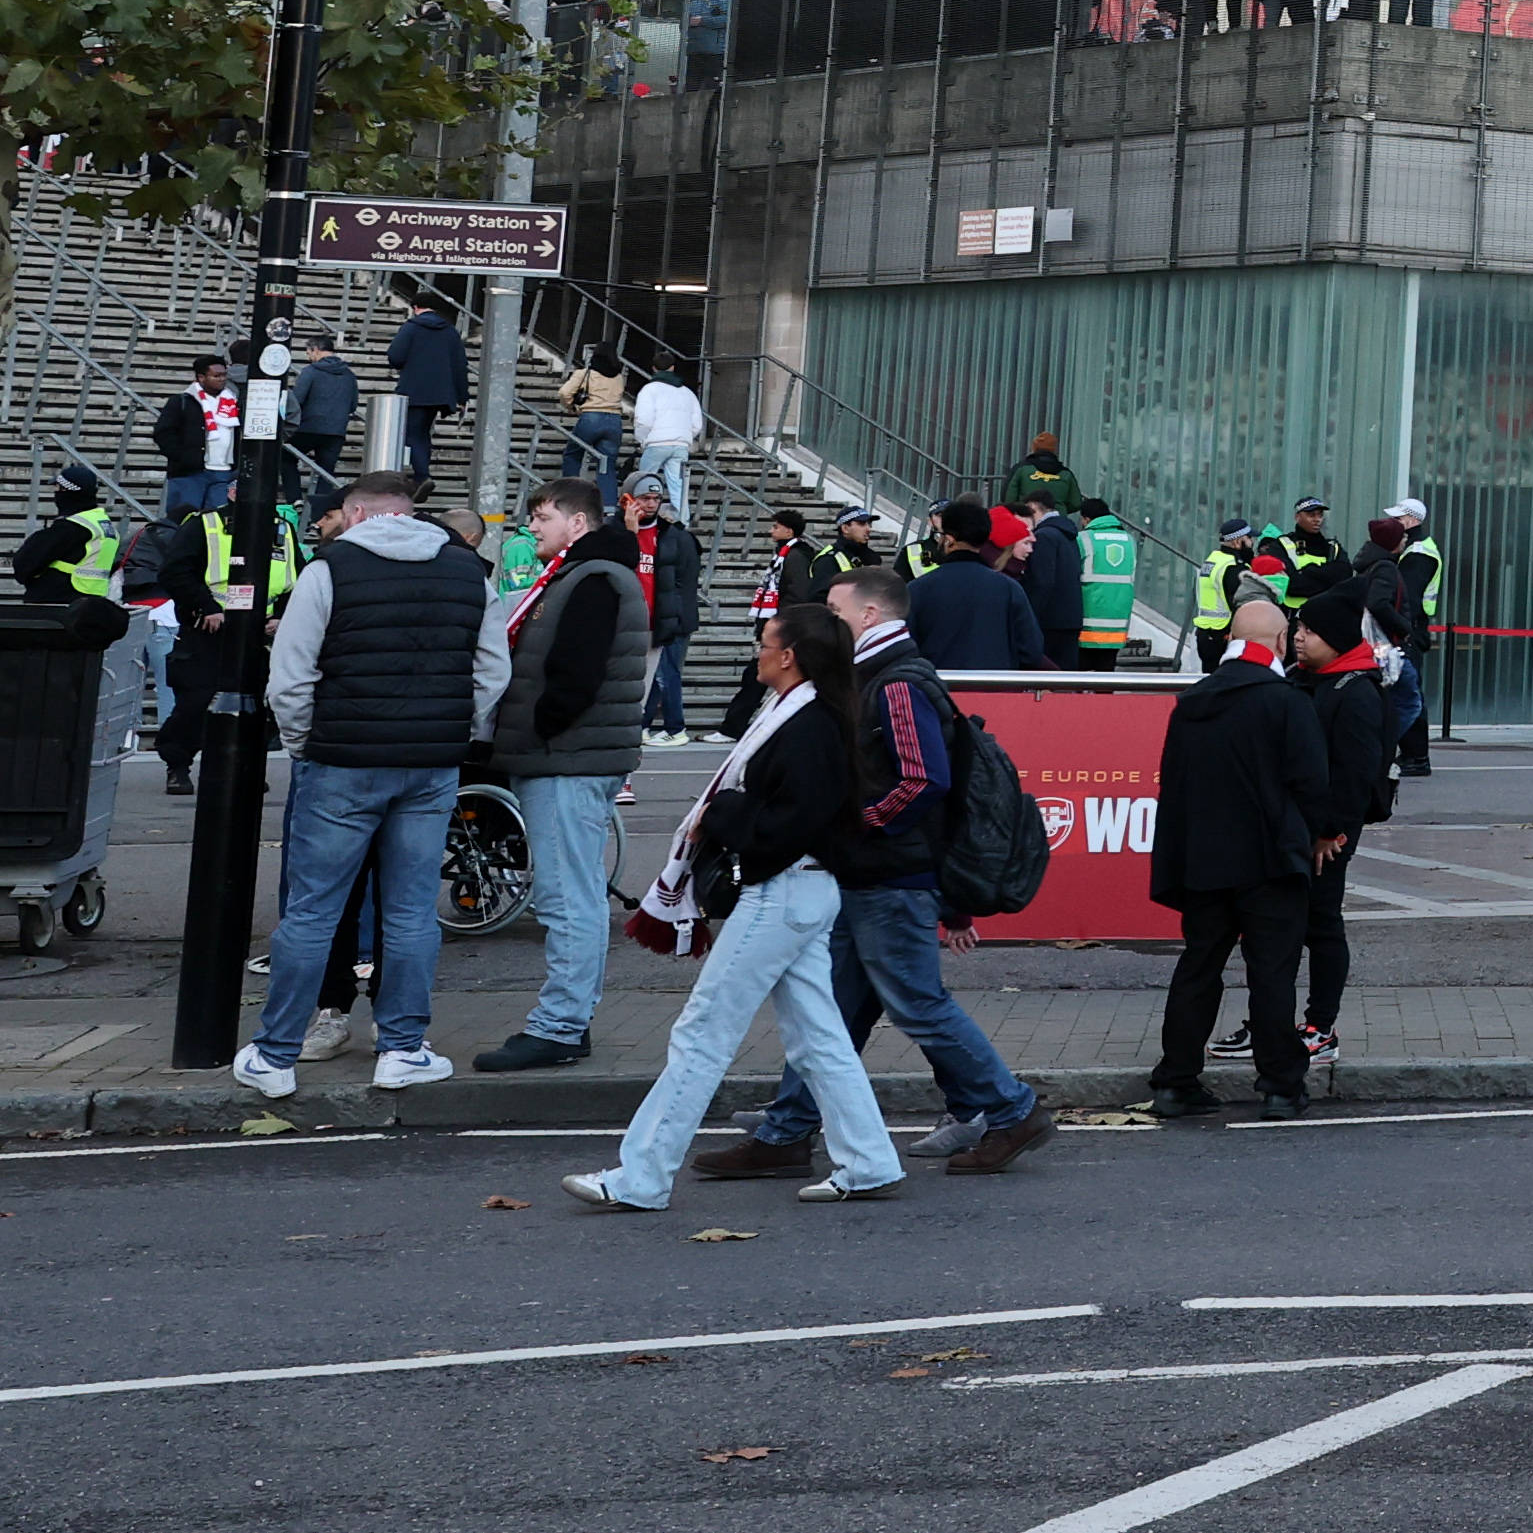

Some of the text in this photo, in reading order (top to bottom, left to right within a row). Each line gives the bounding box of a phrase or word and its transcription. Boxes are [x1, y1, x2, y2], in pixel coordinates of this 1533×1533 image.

[387, 210, 530, 230] Archway Station
[409, 235, 528, 254] Angel Station
[371, 251, 526, 266] via Highbury & Islington Station
[1041, 770, 1142, 783] EUROPE
